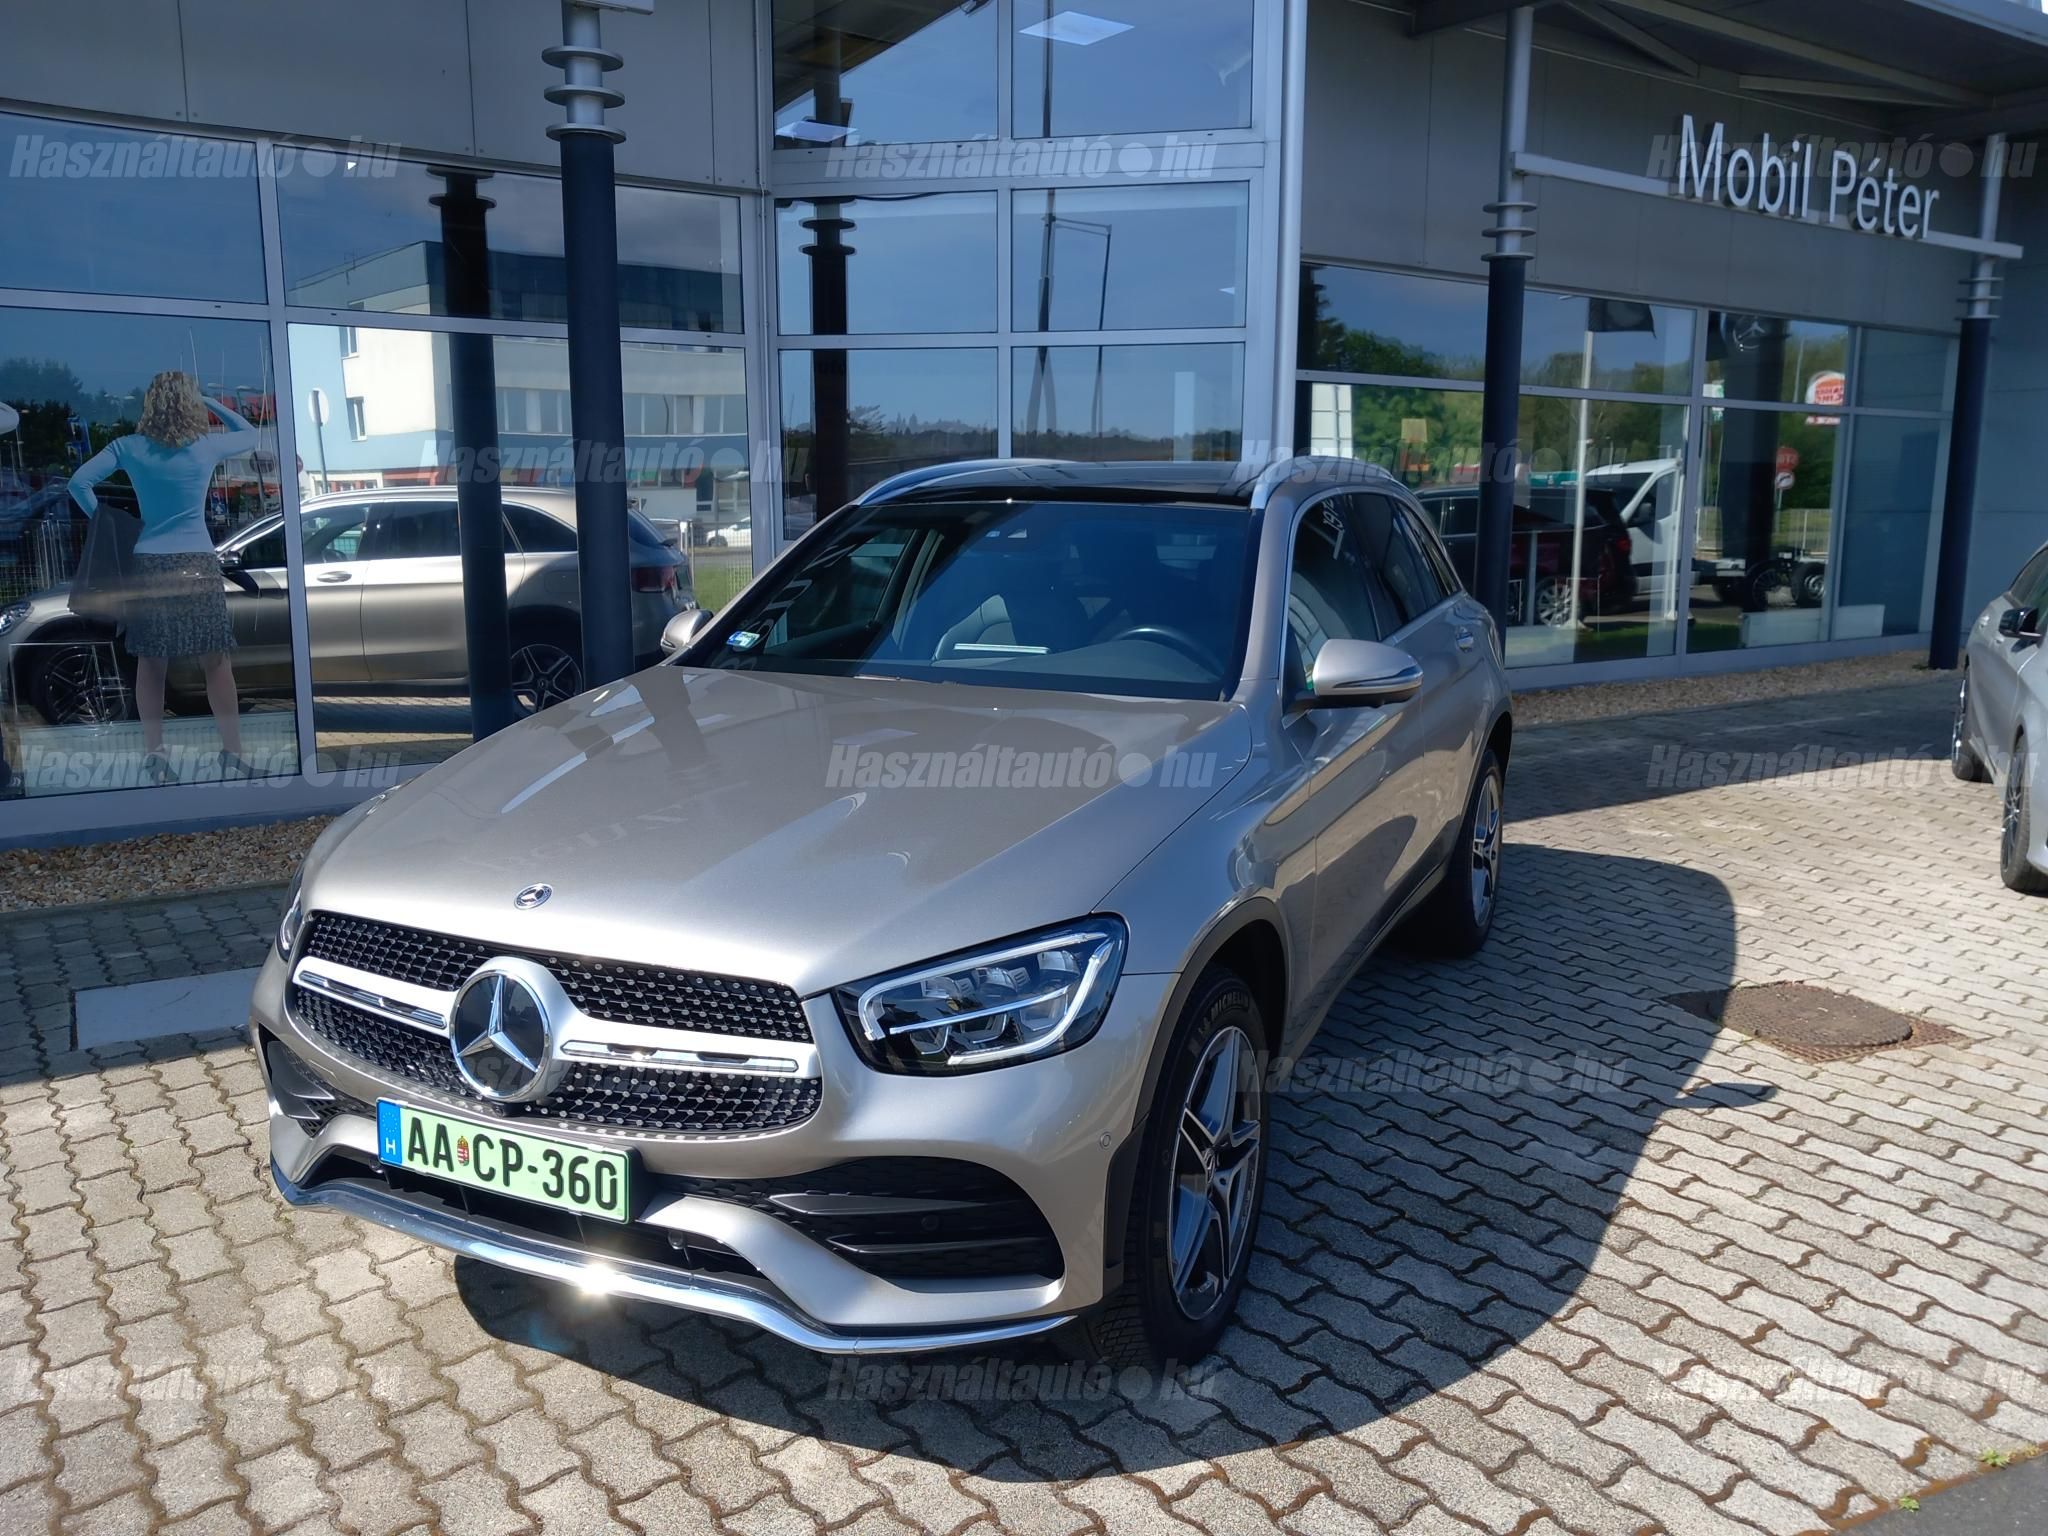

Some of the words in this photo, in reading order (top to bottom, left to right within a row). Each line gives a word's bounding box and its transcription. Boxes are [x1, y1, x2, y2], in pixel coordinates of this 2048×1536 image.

[1678, 114, 1812, 218] Mobil
[1828, 150, 1940, 239] Péter
[385, 1137, 397, 1156] H
[408, 1116, 454, 1172] AA
[472, 1133, 618, 1211] CP-360
